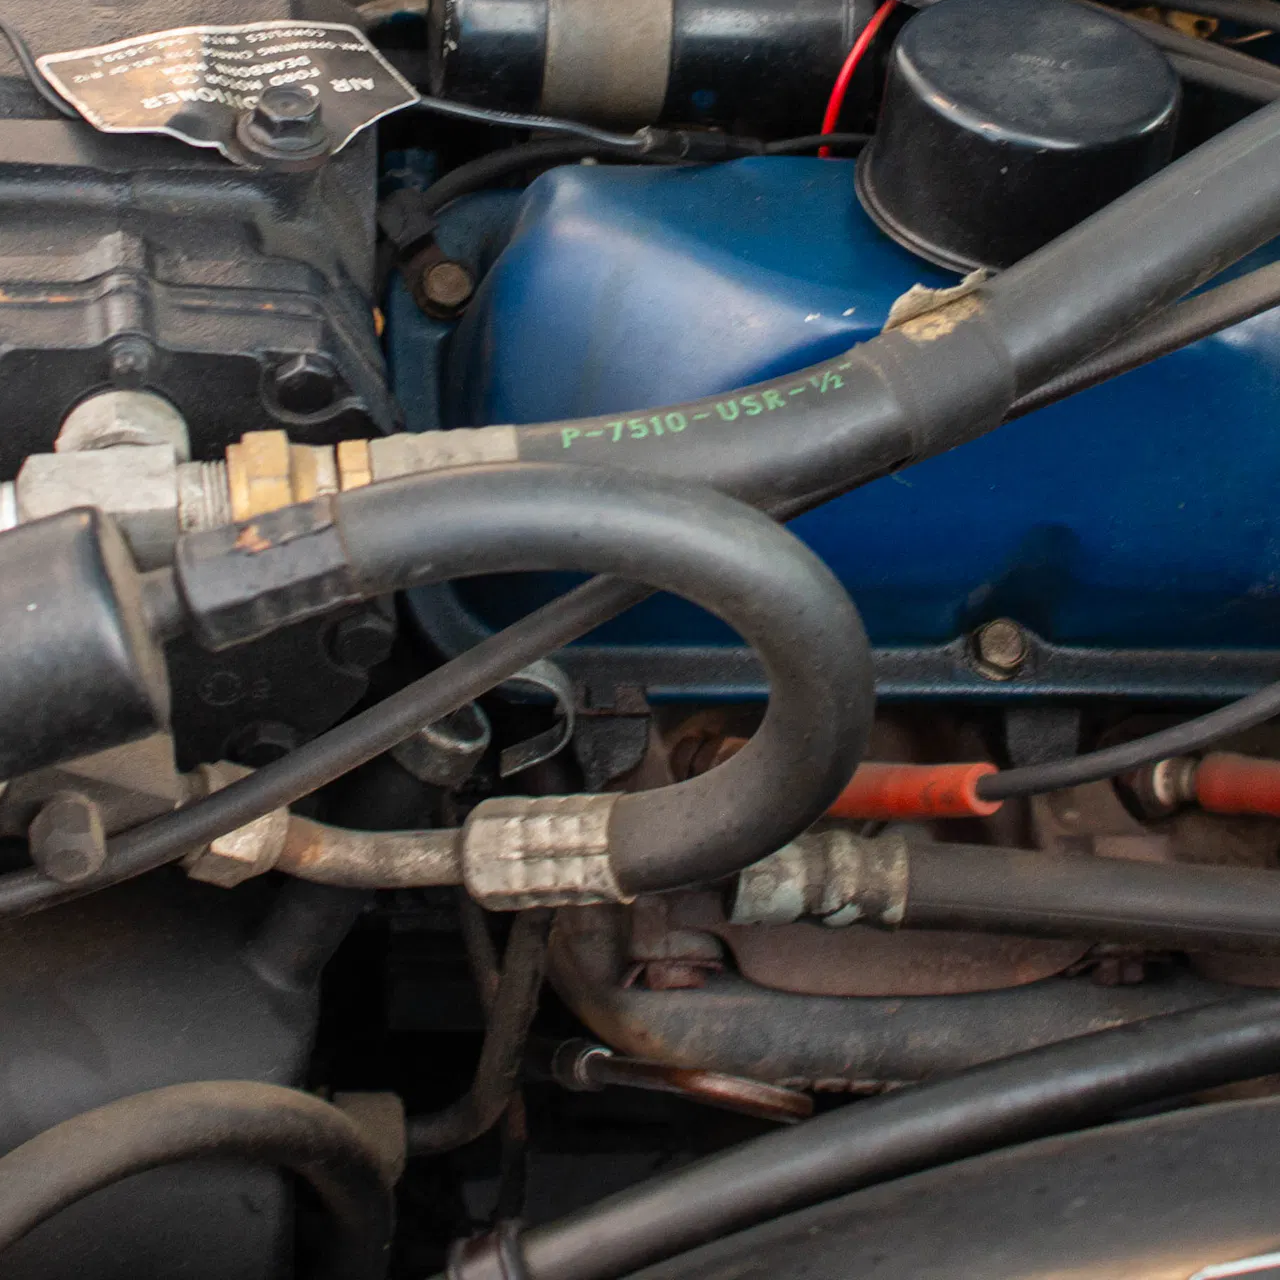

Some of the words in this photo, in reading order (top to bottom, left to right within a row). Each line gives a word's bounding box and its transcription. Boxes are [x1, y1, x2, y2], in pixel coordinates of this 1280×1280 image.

[204, 72, 264, 92] MOTOR
[269, 66, 322, 87] FORD
[329, 77, 375, 93] AIR
[140, 83, 320, 110] CDITIONER
